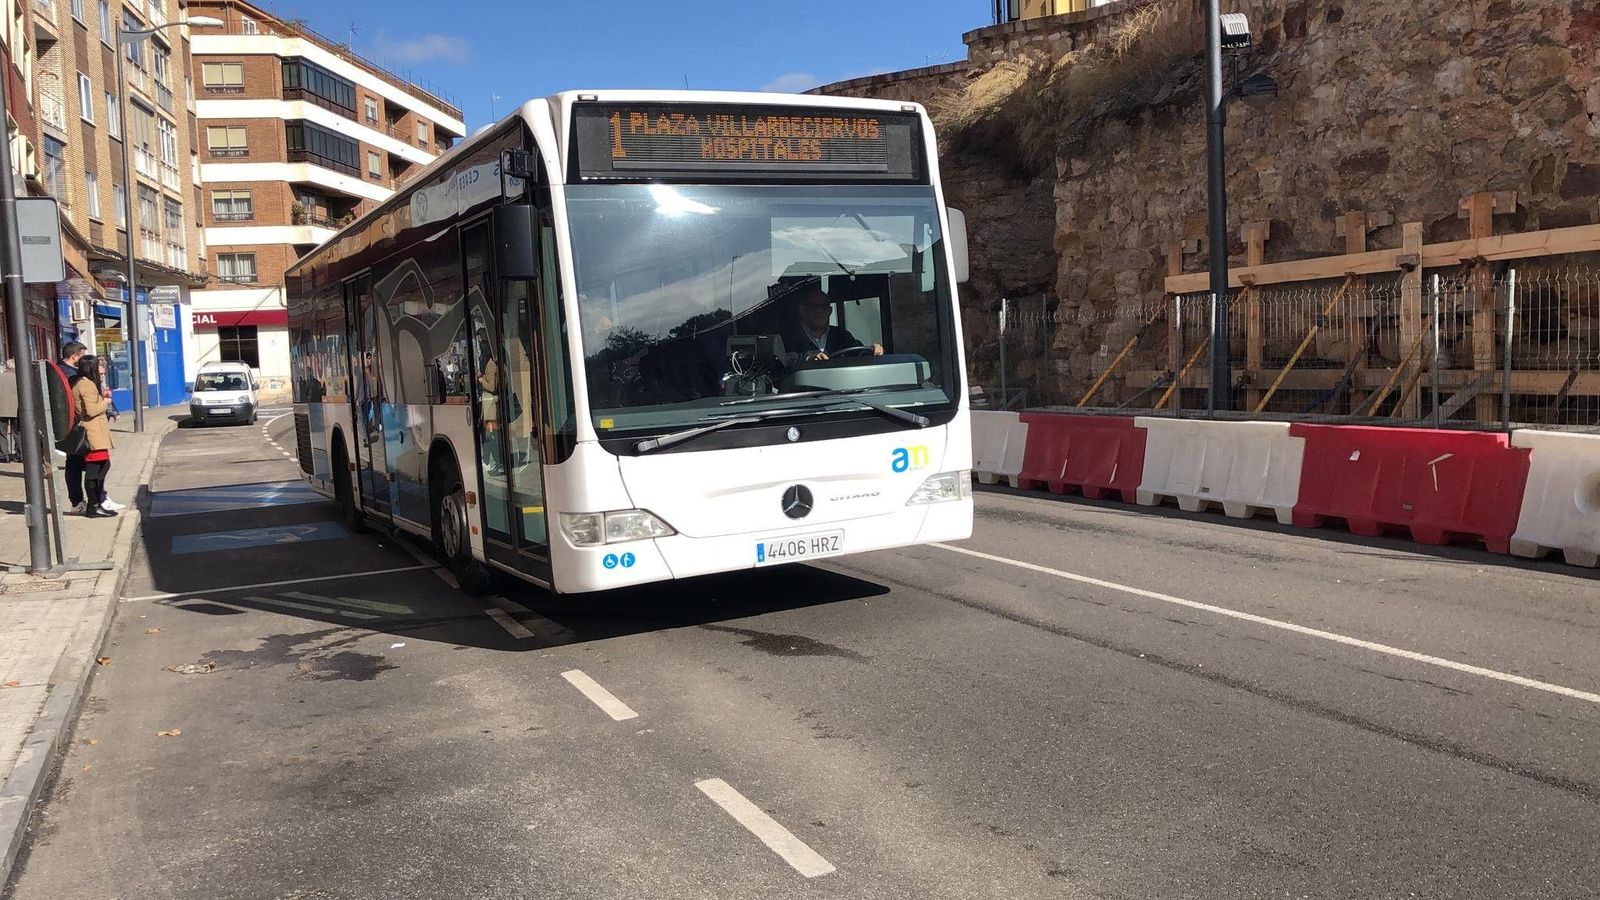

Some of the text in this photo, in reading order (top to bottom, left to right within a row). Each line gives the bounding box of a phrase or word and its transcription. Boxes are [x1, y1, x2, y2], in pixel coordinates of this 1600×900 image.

[610, 111, 626, 157] 1
[630, 112, 699, 135] PLAZA
[701, 137, 822, 160] HOSPITALES
[768, 535, 839, 558] 4406 HRZ
